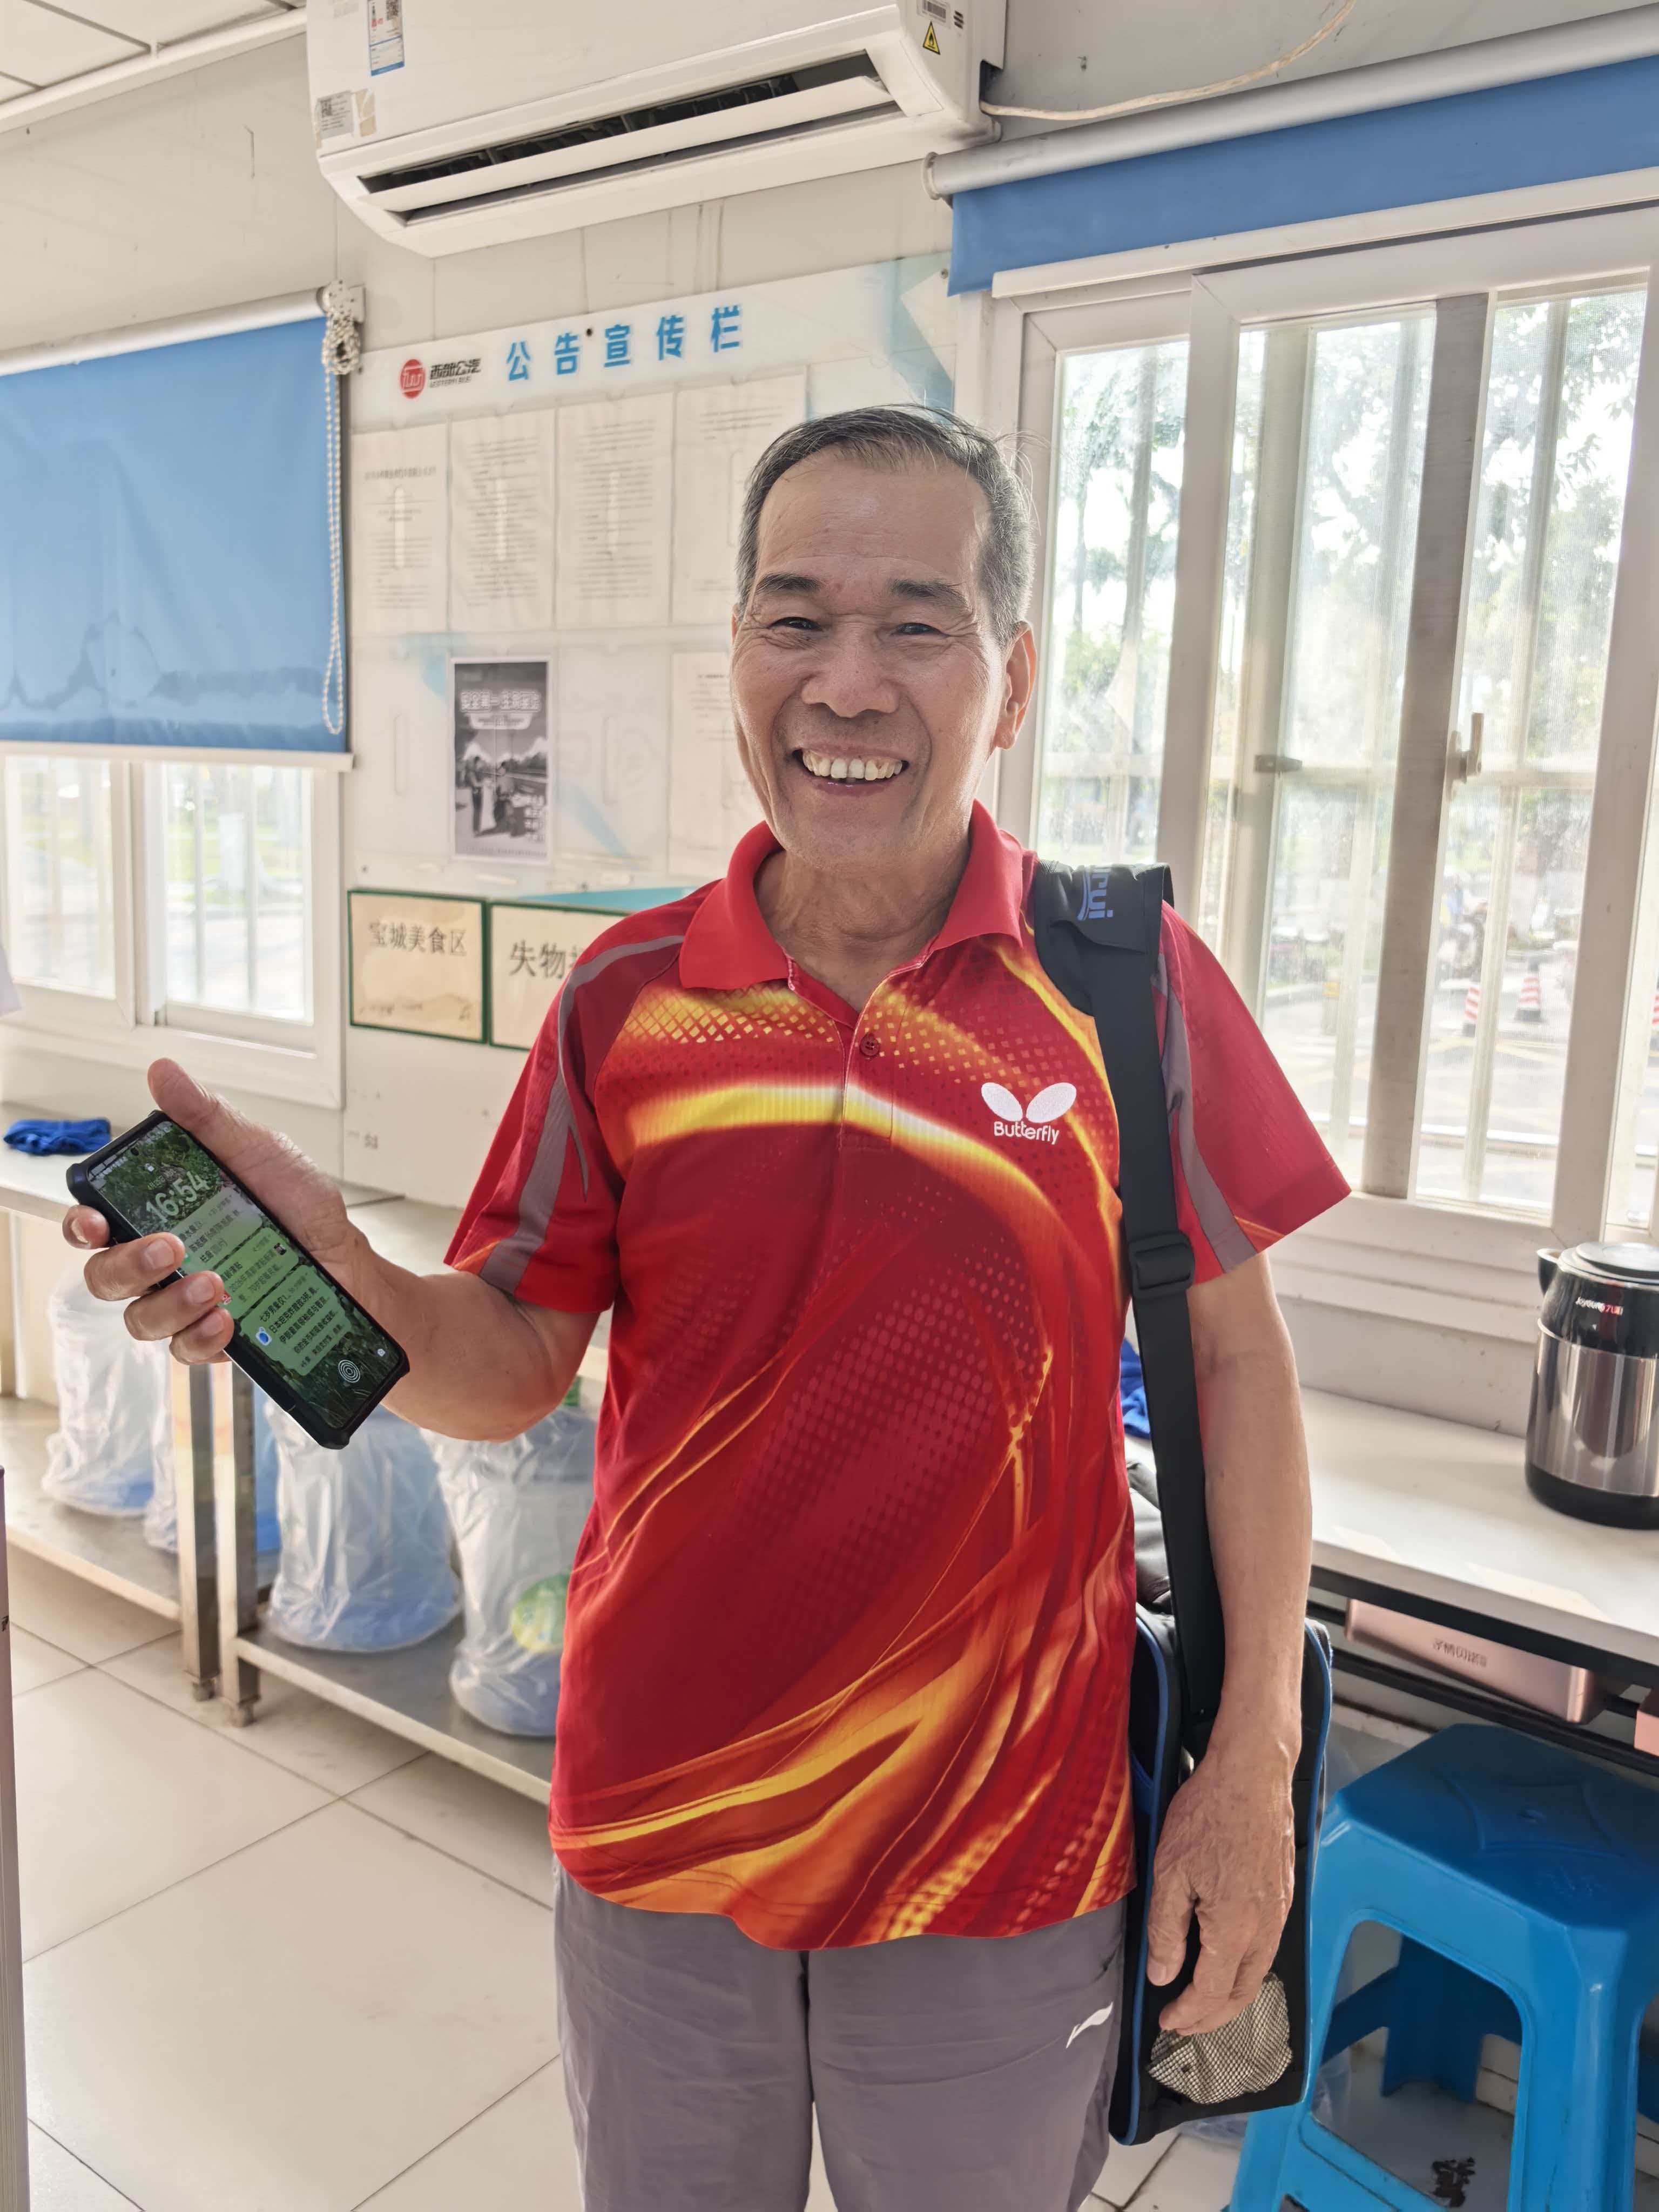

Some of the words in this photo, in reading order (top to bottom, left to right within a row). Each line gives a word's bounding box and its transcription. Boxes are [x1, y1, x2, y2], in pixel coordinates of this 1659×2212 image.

[505, 304, 743, 381] 公告宣传栏
[369, 920, 468, 956] 宝城美食区
[994, 1121, 1060, 1145] Butterfly
[146, 1171, 210, 1223] 16:54
